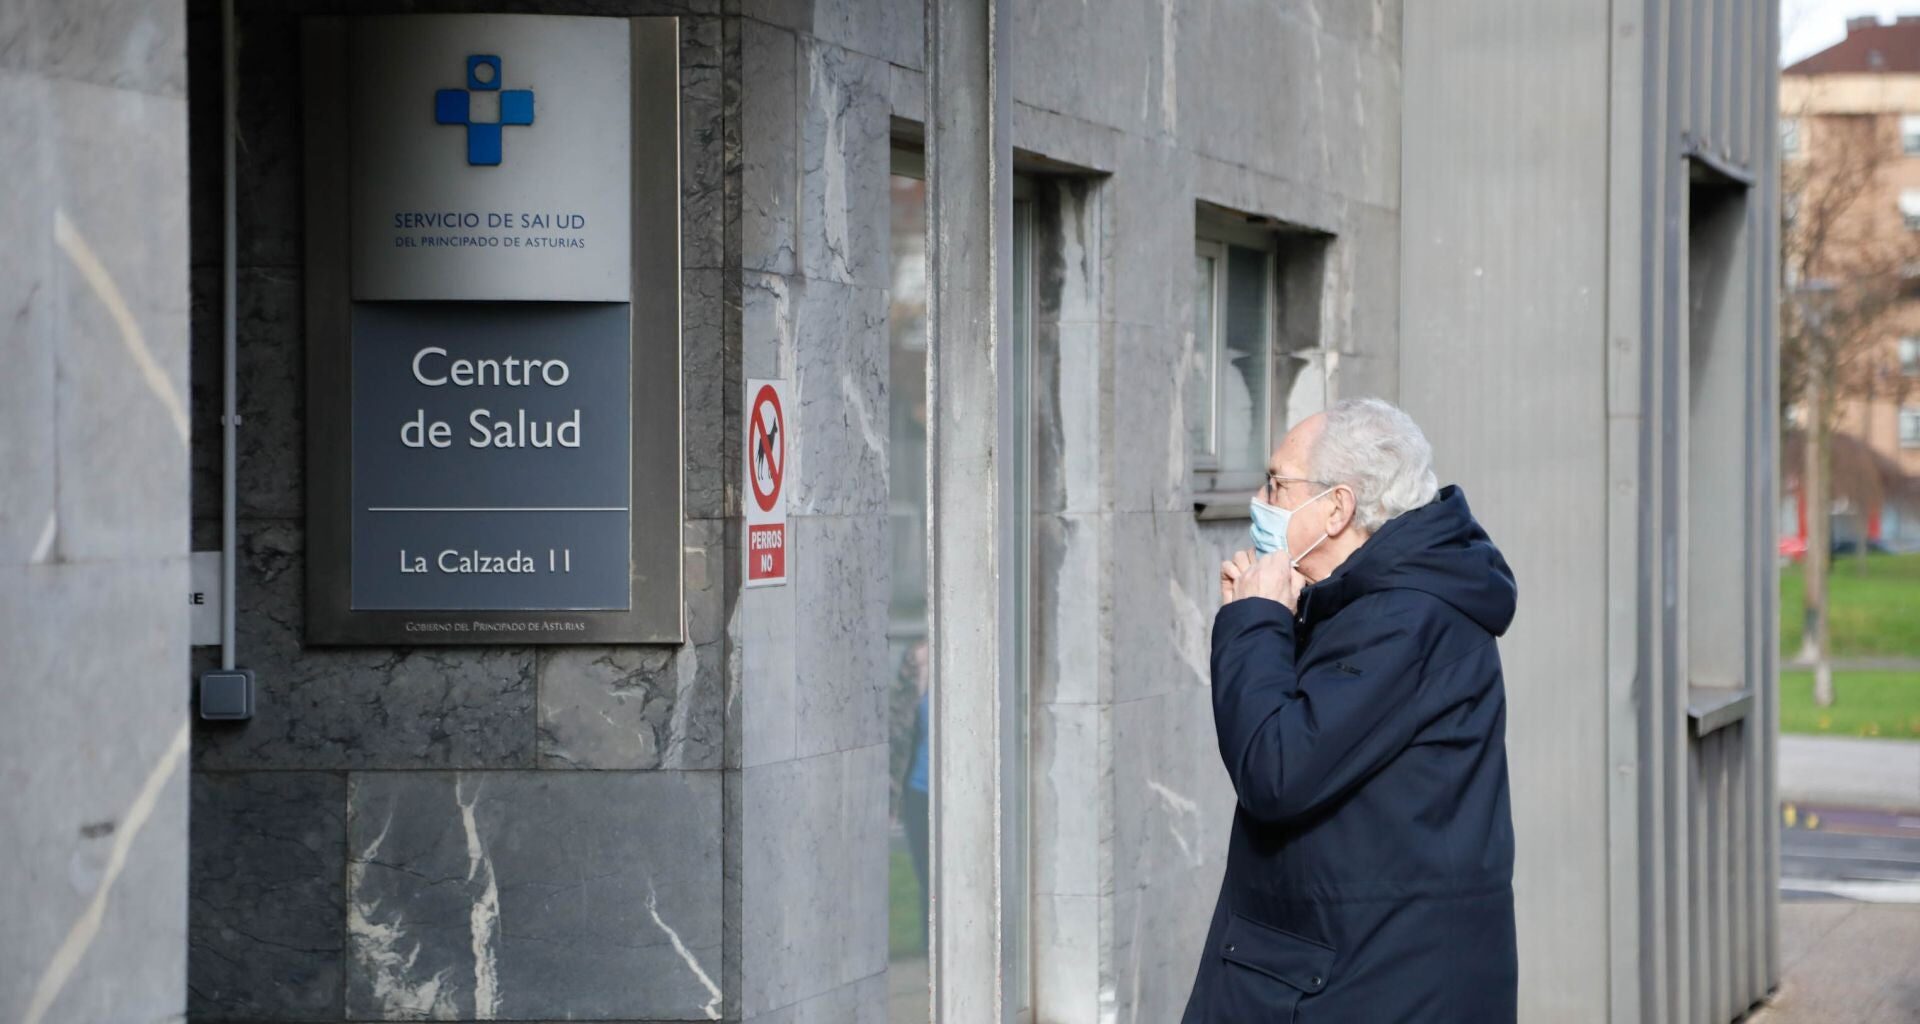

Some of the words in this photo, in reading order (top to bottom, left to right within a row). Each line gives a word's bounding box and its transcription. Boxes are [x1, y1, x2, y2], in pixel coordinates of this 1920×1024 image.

[394, 213, 479, 229] SERVICIO
[488, 213, 513, 228] DE
[395, 237, 417, 248] DEL
[421, 236, 499, 248] PRINCIPADO
[503, 237, 520, 248] DE
[525, 237, 585, 249] ASTURIAS
[412, 346, 570, 386] Centro
[400, 409, 451, 448] de
[469, 409, 581, 448] Salud
[751, 529, 782, 549] PERROS
[400, 549, 428, 573] La
[437, 549, 535, 573] Calzada
[761, 554, 773, 573] NO
